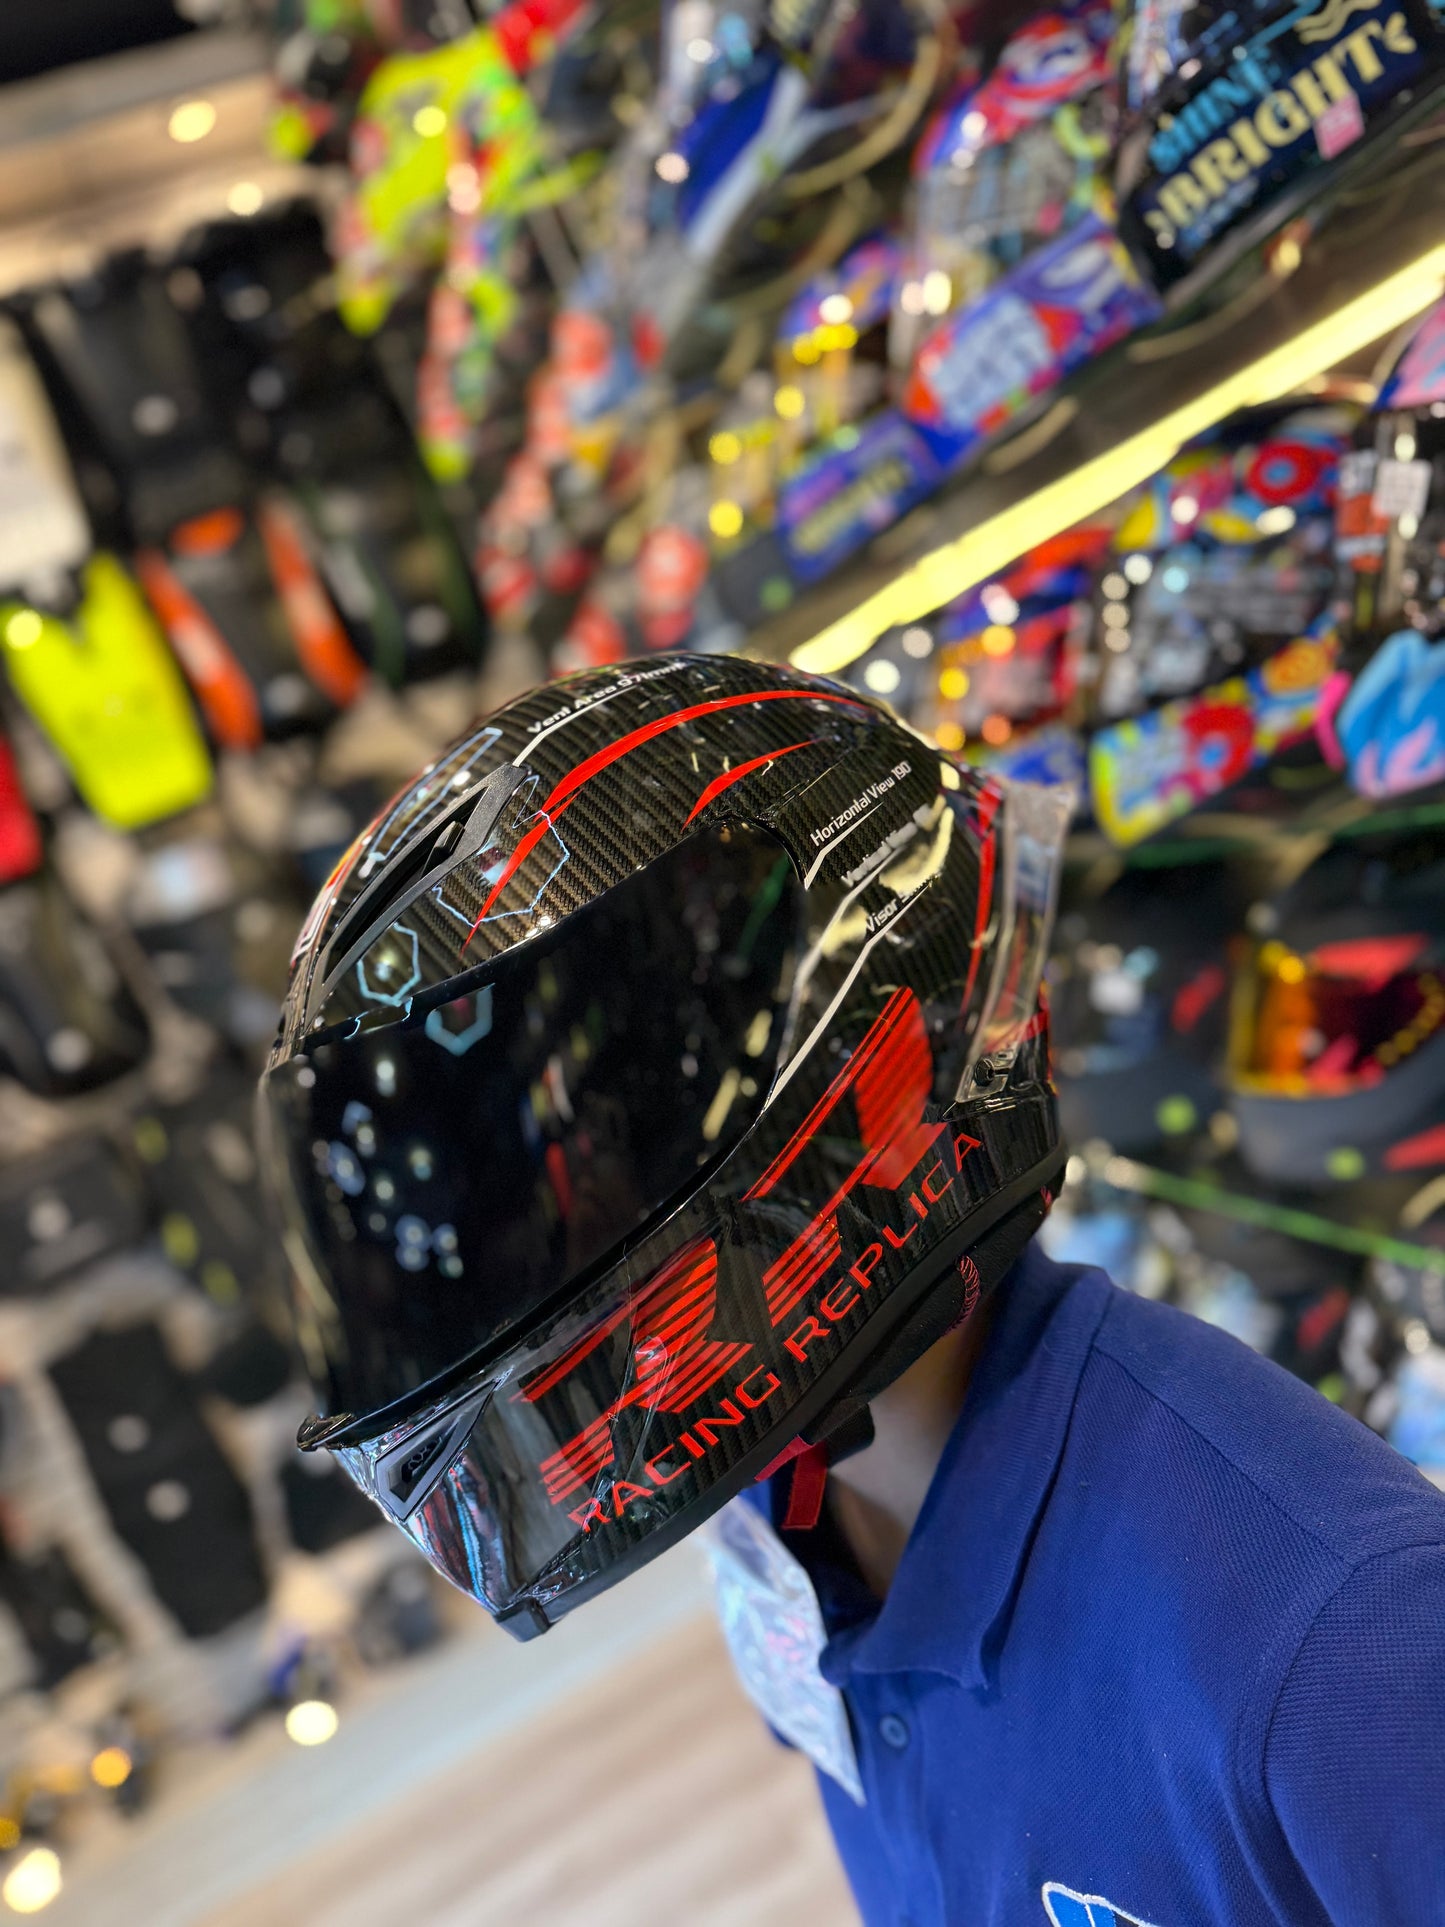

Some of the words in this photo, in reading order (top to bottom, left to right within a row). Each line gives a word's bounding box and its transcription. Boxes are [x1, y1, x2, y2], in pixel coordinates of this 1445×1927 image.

[1158, 18, 1383, 228] BRIGHT
[526, 706, 572, 733] Vent
[574, 685, 618, 710] Area
[809, 791, 872, 847] Horizontal
[866, 776, 895, 799] View
[865, 898, 898, 932] Visor
[567, 1364, 781, 1533] RACING
[782, 1132, 982, 1363] REPLICA
